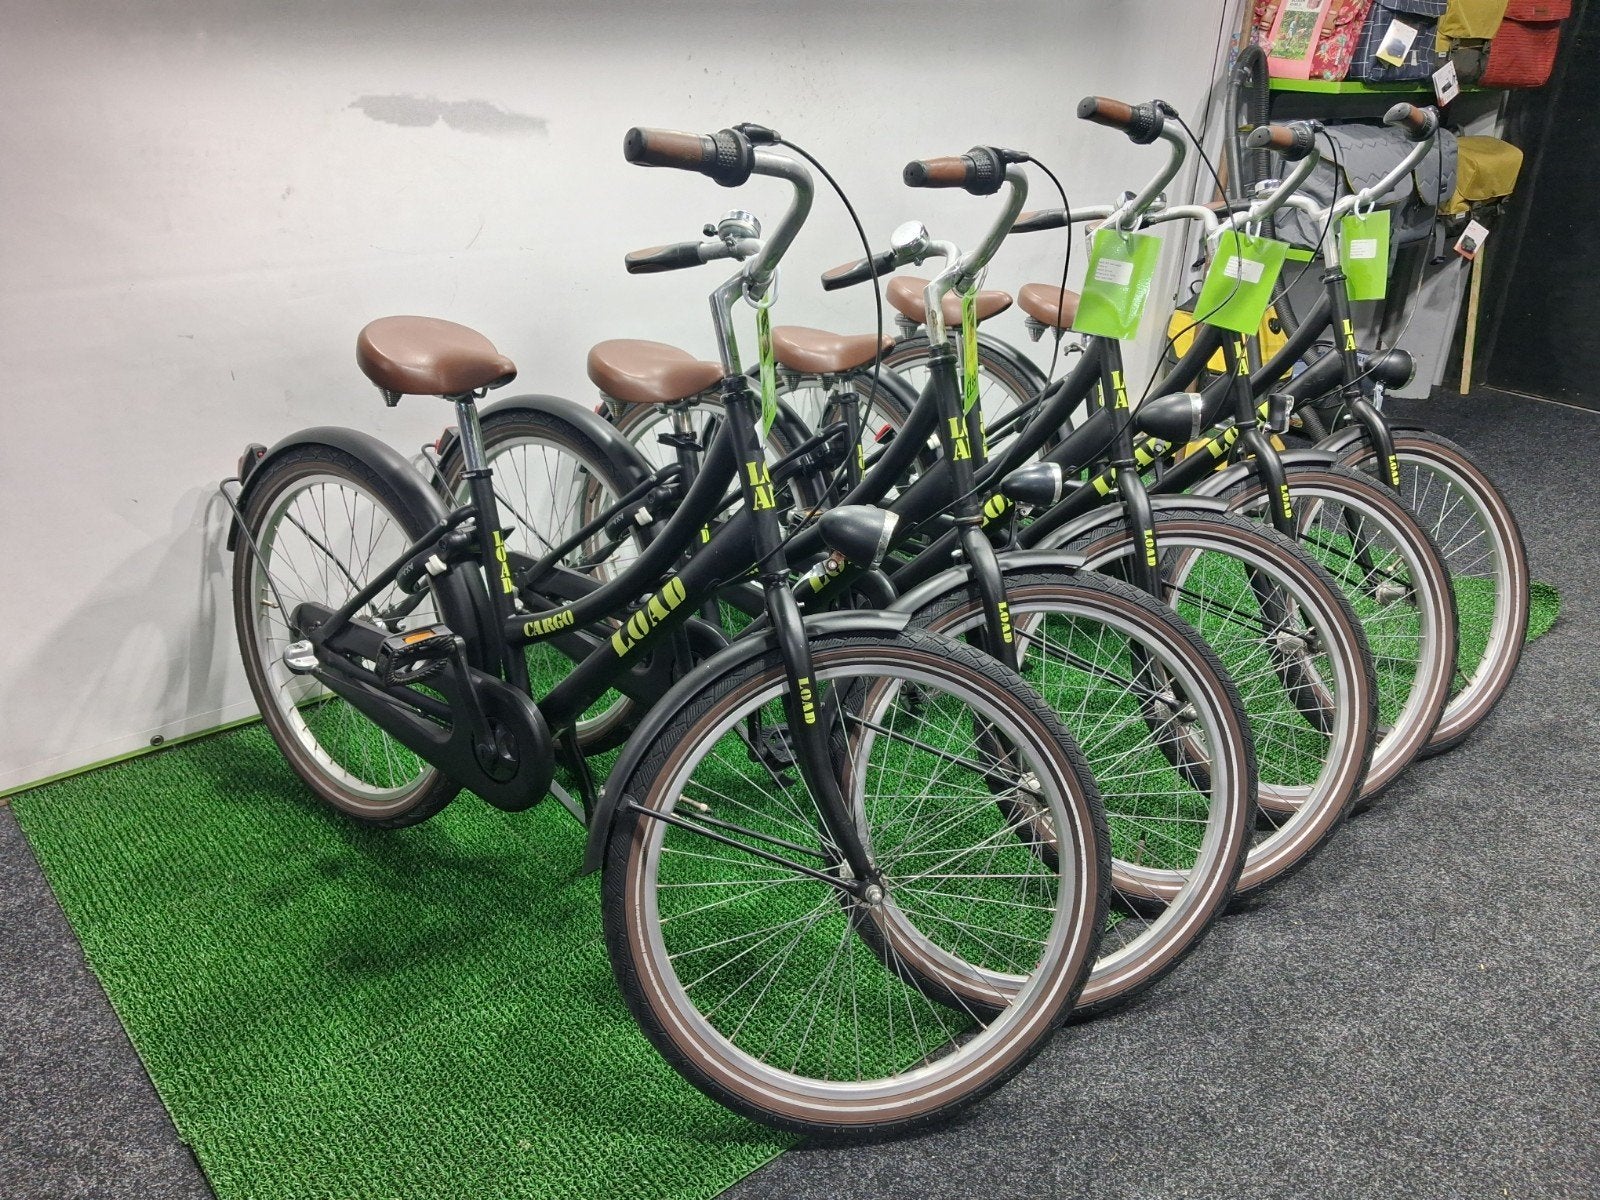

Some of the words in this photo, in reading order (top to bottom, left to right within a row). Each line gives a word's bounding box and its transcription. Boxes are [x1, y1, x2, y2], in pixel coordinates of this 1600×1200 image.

[1388, 454, 1400, 486] LOAD
[1280, 484, 1292, 519] LOAD
[1143, 529, 1156, 567] LOAD
[523, 609, 575, 638] CARGO
[611, 576, 686, 657] LOAD
[998, 601, 1013, 644] LOAD
[798, 676, 816, 724] LOAD
